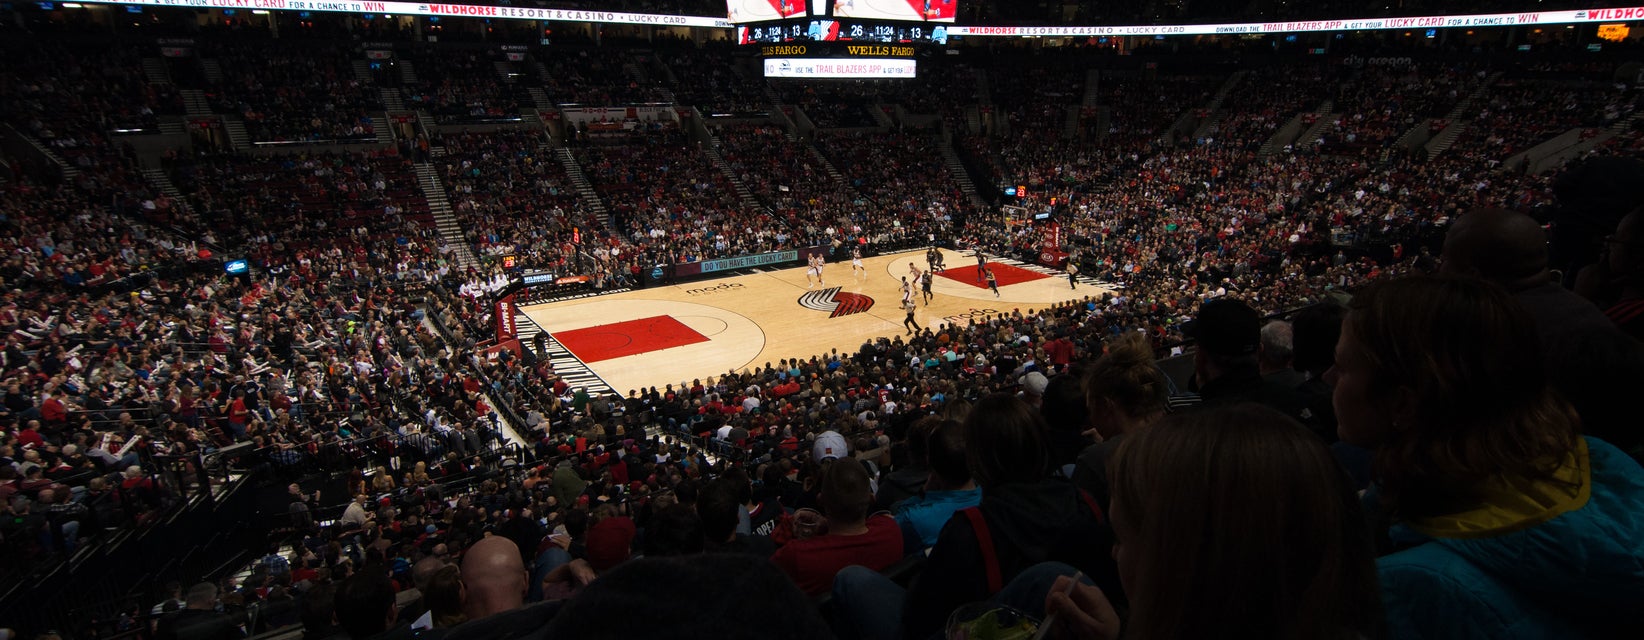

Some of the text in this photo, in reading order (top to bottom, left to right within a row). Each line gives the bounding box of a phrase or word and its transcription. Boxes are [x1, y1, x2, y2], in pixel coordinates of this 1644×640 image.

[254, 0, 286, 8] CARD
[317, 3, 348, 11] CHANCE
[363, 2, 385, 12] WIN
[429, 4, 497, 16] WILDHORSE
[502, 8, 552, 18] RESORT
[556, 10, 563, 19] &
[567, 11, 614, 21] CASINO
[628, 14, 660, 23] LUCKY
[663, 16, 687, 24] CARD
[1588, 8, 1644, 20] WILDHO
[1263, 23, 1284, 32] TRAIL
[1286, 22, 1322, 31] BLAZERS
[1324, 21, 1342, 29] APP
[1385, 18, 1416, 28] LUCKY
[1418, 17, 1445, 27] CARD
[1473, 17, 1503, 25] CHANCE
[1518, 13, 1540, 23] WIN
[754, 28, 762, 39] 26
[768, 26, 781, 35] 11:24
[792, 25, 800, 37] 13
[851, 25, 863, 36] 26
[875, 26, 894, 35] 11:24
[910, 28, 921, 39] 13
[775, 45, 807, 55] FARGO
[847, 45, 915, 56] WELLS FARGO
[816, 64, 834, 74] TRAIL
[836, 64, 867, 74] BLAZERS
[868, 64, 882, 74] APP
[704, 262, 713, 271] DO
[715, 261, 728, 269] YOU
[729, 258, 744, 268] HAVE
[746, 257, 757, 266] THE
[758, 253, 776, 264] LUCKY
[686, 282, 744, 295] moda
[500, 302, 511, 334] BI-MART
[752, 519, 775, 536] OPEZ
